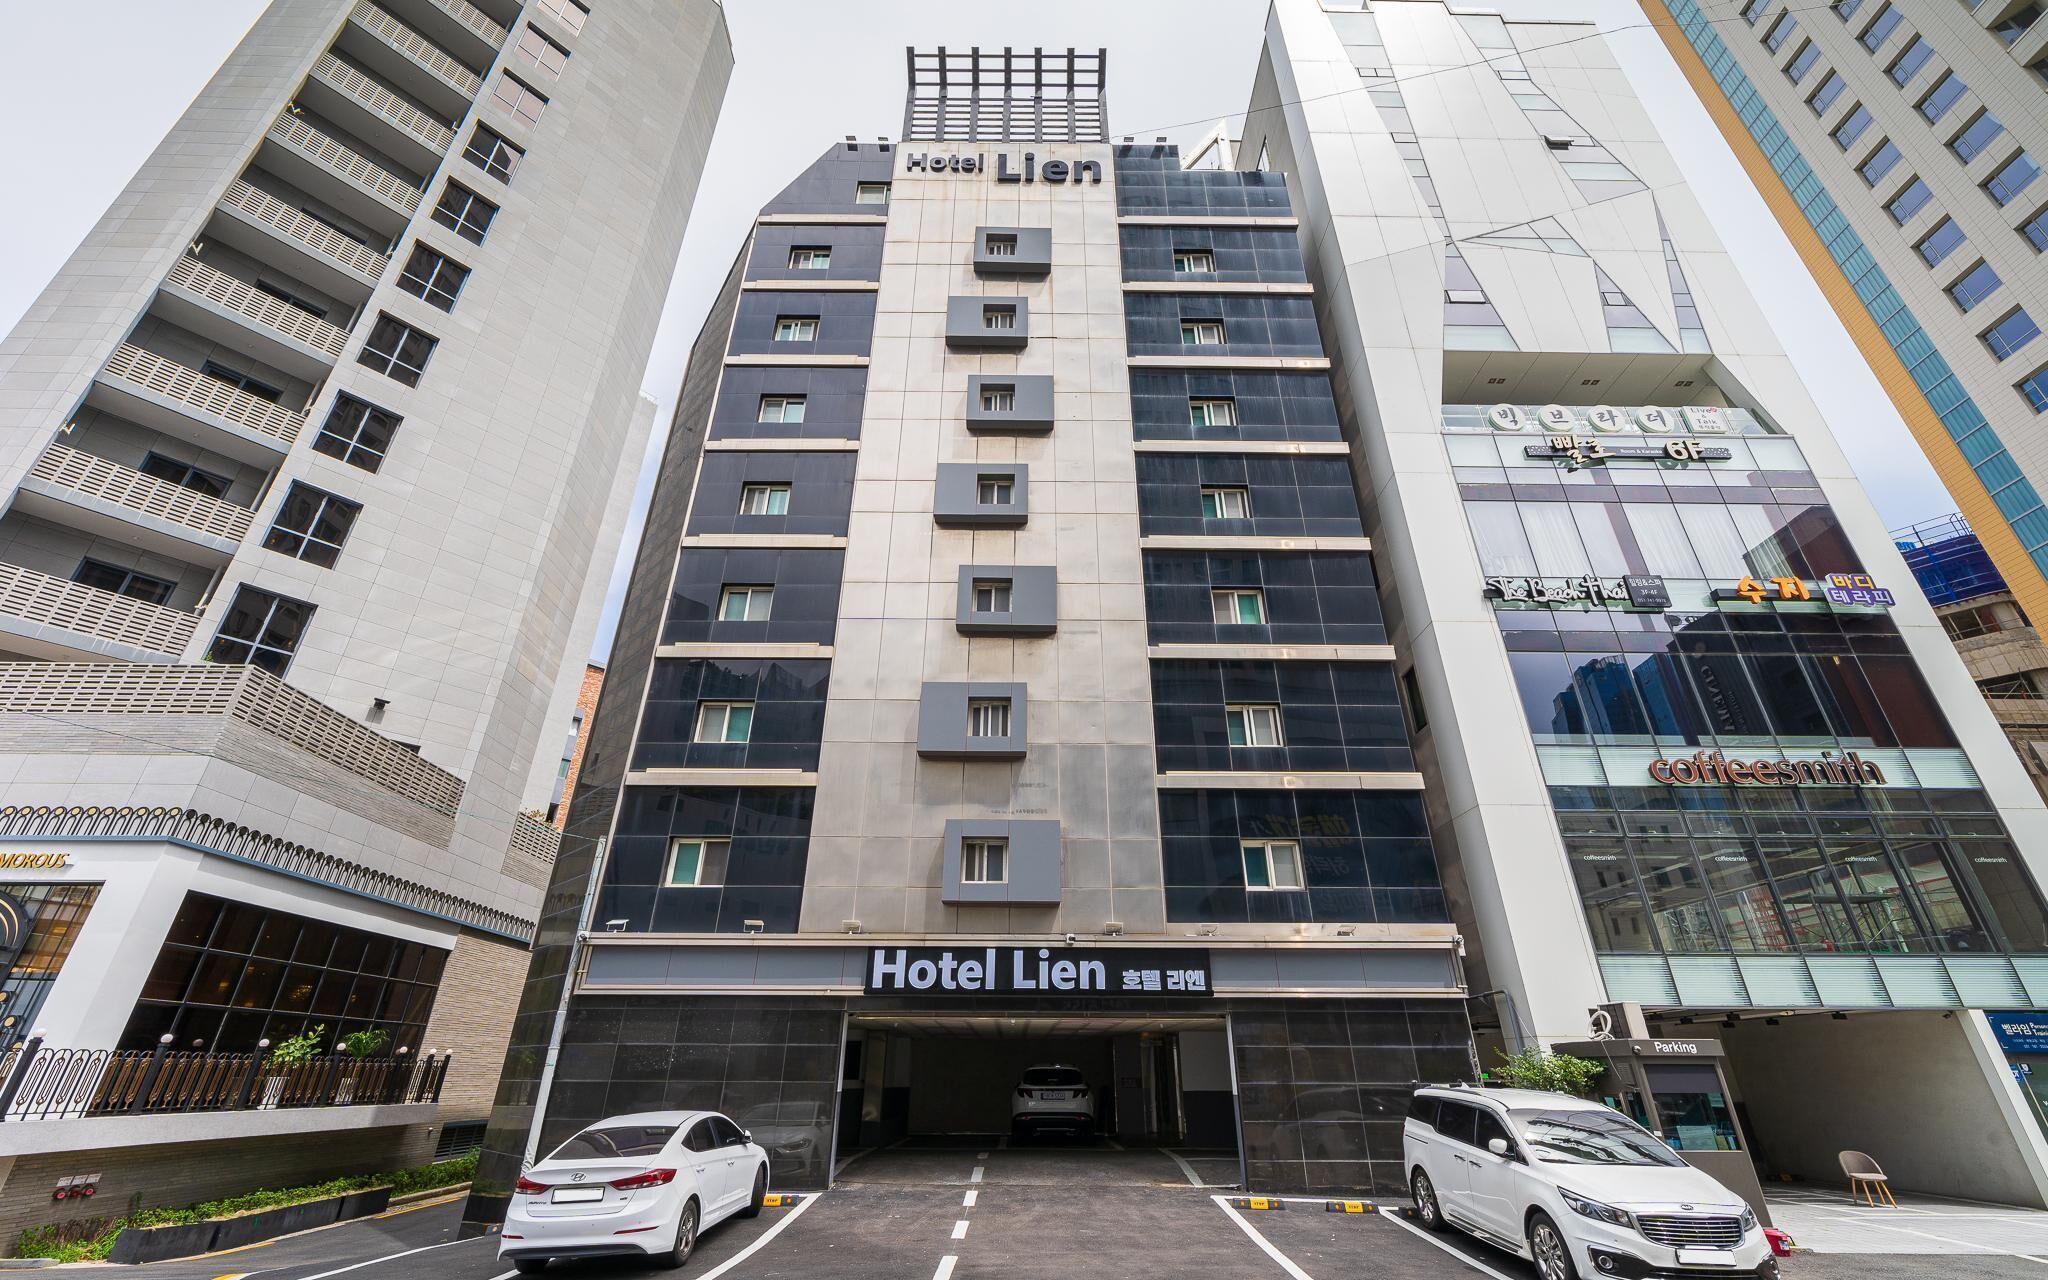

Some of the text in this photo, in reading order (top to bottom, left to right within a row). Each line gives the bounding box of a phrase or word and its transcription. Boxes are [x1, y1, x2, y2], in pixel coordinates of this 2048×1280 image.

[907, 152, 1101, 184] Hotel Lien
[1665, 440, 1704, 460] 6F
[1832, 575, 1875, 589] 바디
[1487, 576, 1528, 602] The
[1526, 577, 1586, 604] Beach
[1737, 575, 1811, 604] 수지
[1831, 590, 1893, 604] 테라피
[1649, 750, 1888, 786] coffeesmith
[1583, 854, 1617, 862] coffeesmith
[1715, 855, 1748, 863] coffeesmith
[1845, 855, 1878, 863] coffeesmith
[1974, 856, 2008, 864] coffeesmith
[872, 948, 1206, 991] Hotel Lien 호텔 리엔
[1654, 1041, 1698, 1054] Parking
